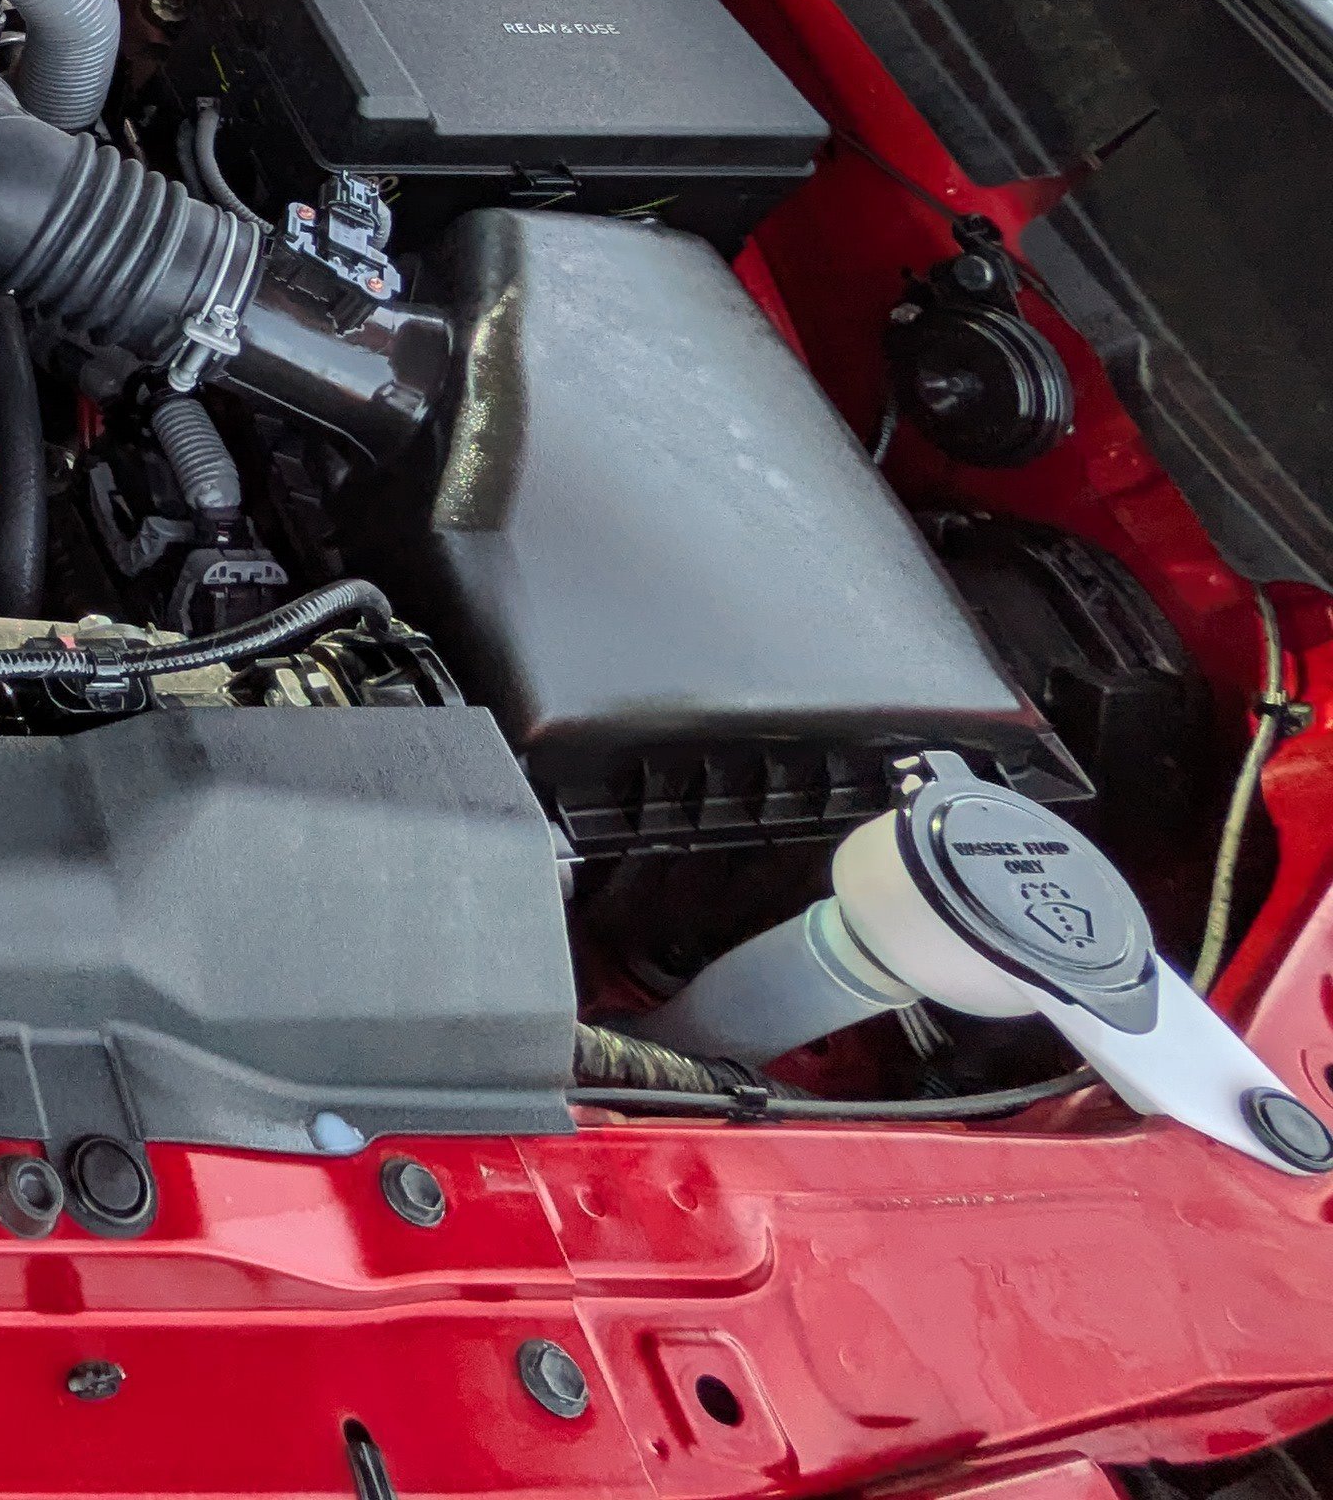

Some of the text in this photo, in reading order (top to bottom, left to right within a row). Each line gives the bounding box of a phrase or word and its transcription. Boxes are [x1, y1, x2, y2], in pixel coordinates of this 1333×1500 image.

[502, 22, 621, 35] RELAY & FUSE
[1003, 859, 1045, 874] ONLY
